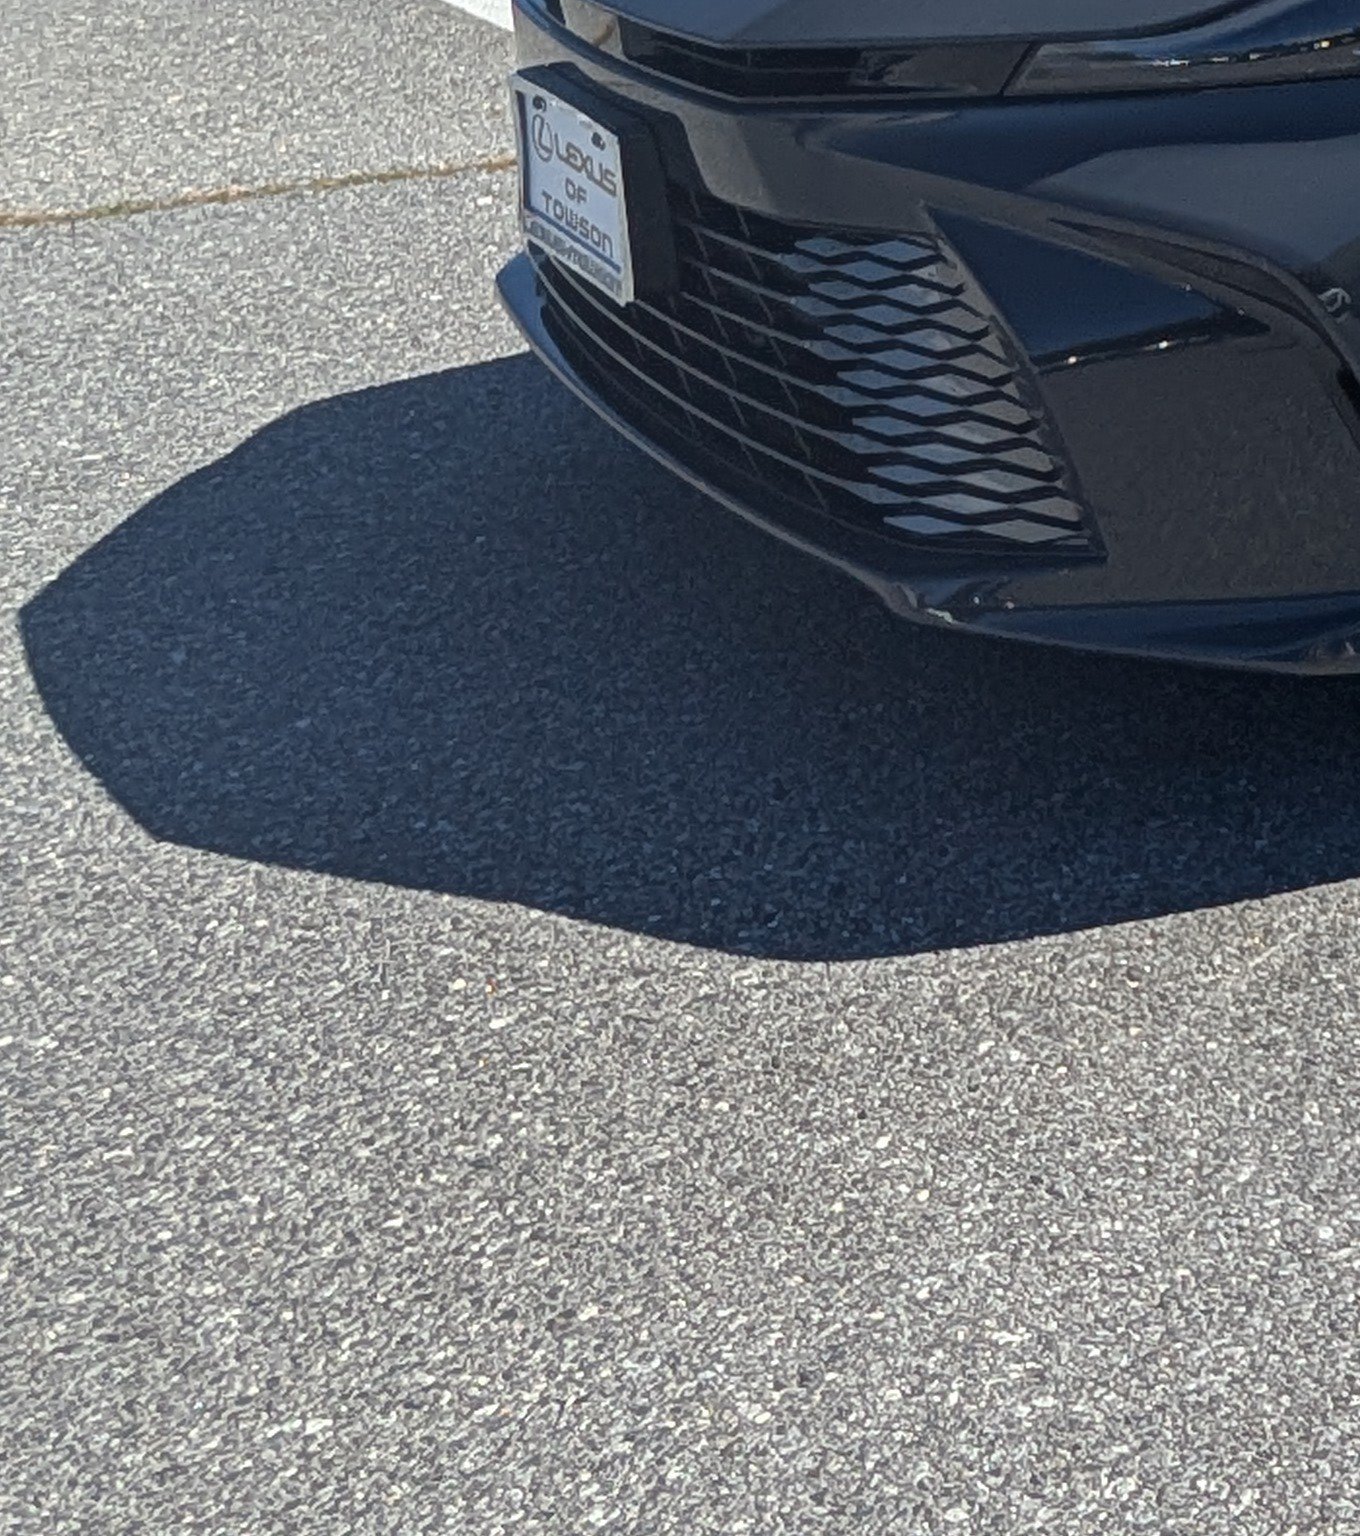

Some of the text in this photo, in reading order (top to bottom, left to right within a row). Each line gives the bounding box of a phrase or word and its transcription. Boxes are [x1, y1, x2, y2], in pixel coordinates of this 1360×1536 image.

[554, 133, 617, 197] LEXUS
[564, 177, 588, 204] OF
[541, 190, 613, 257] TOWSON
